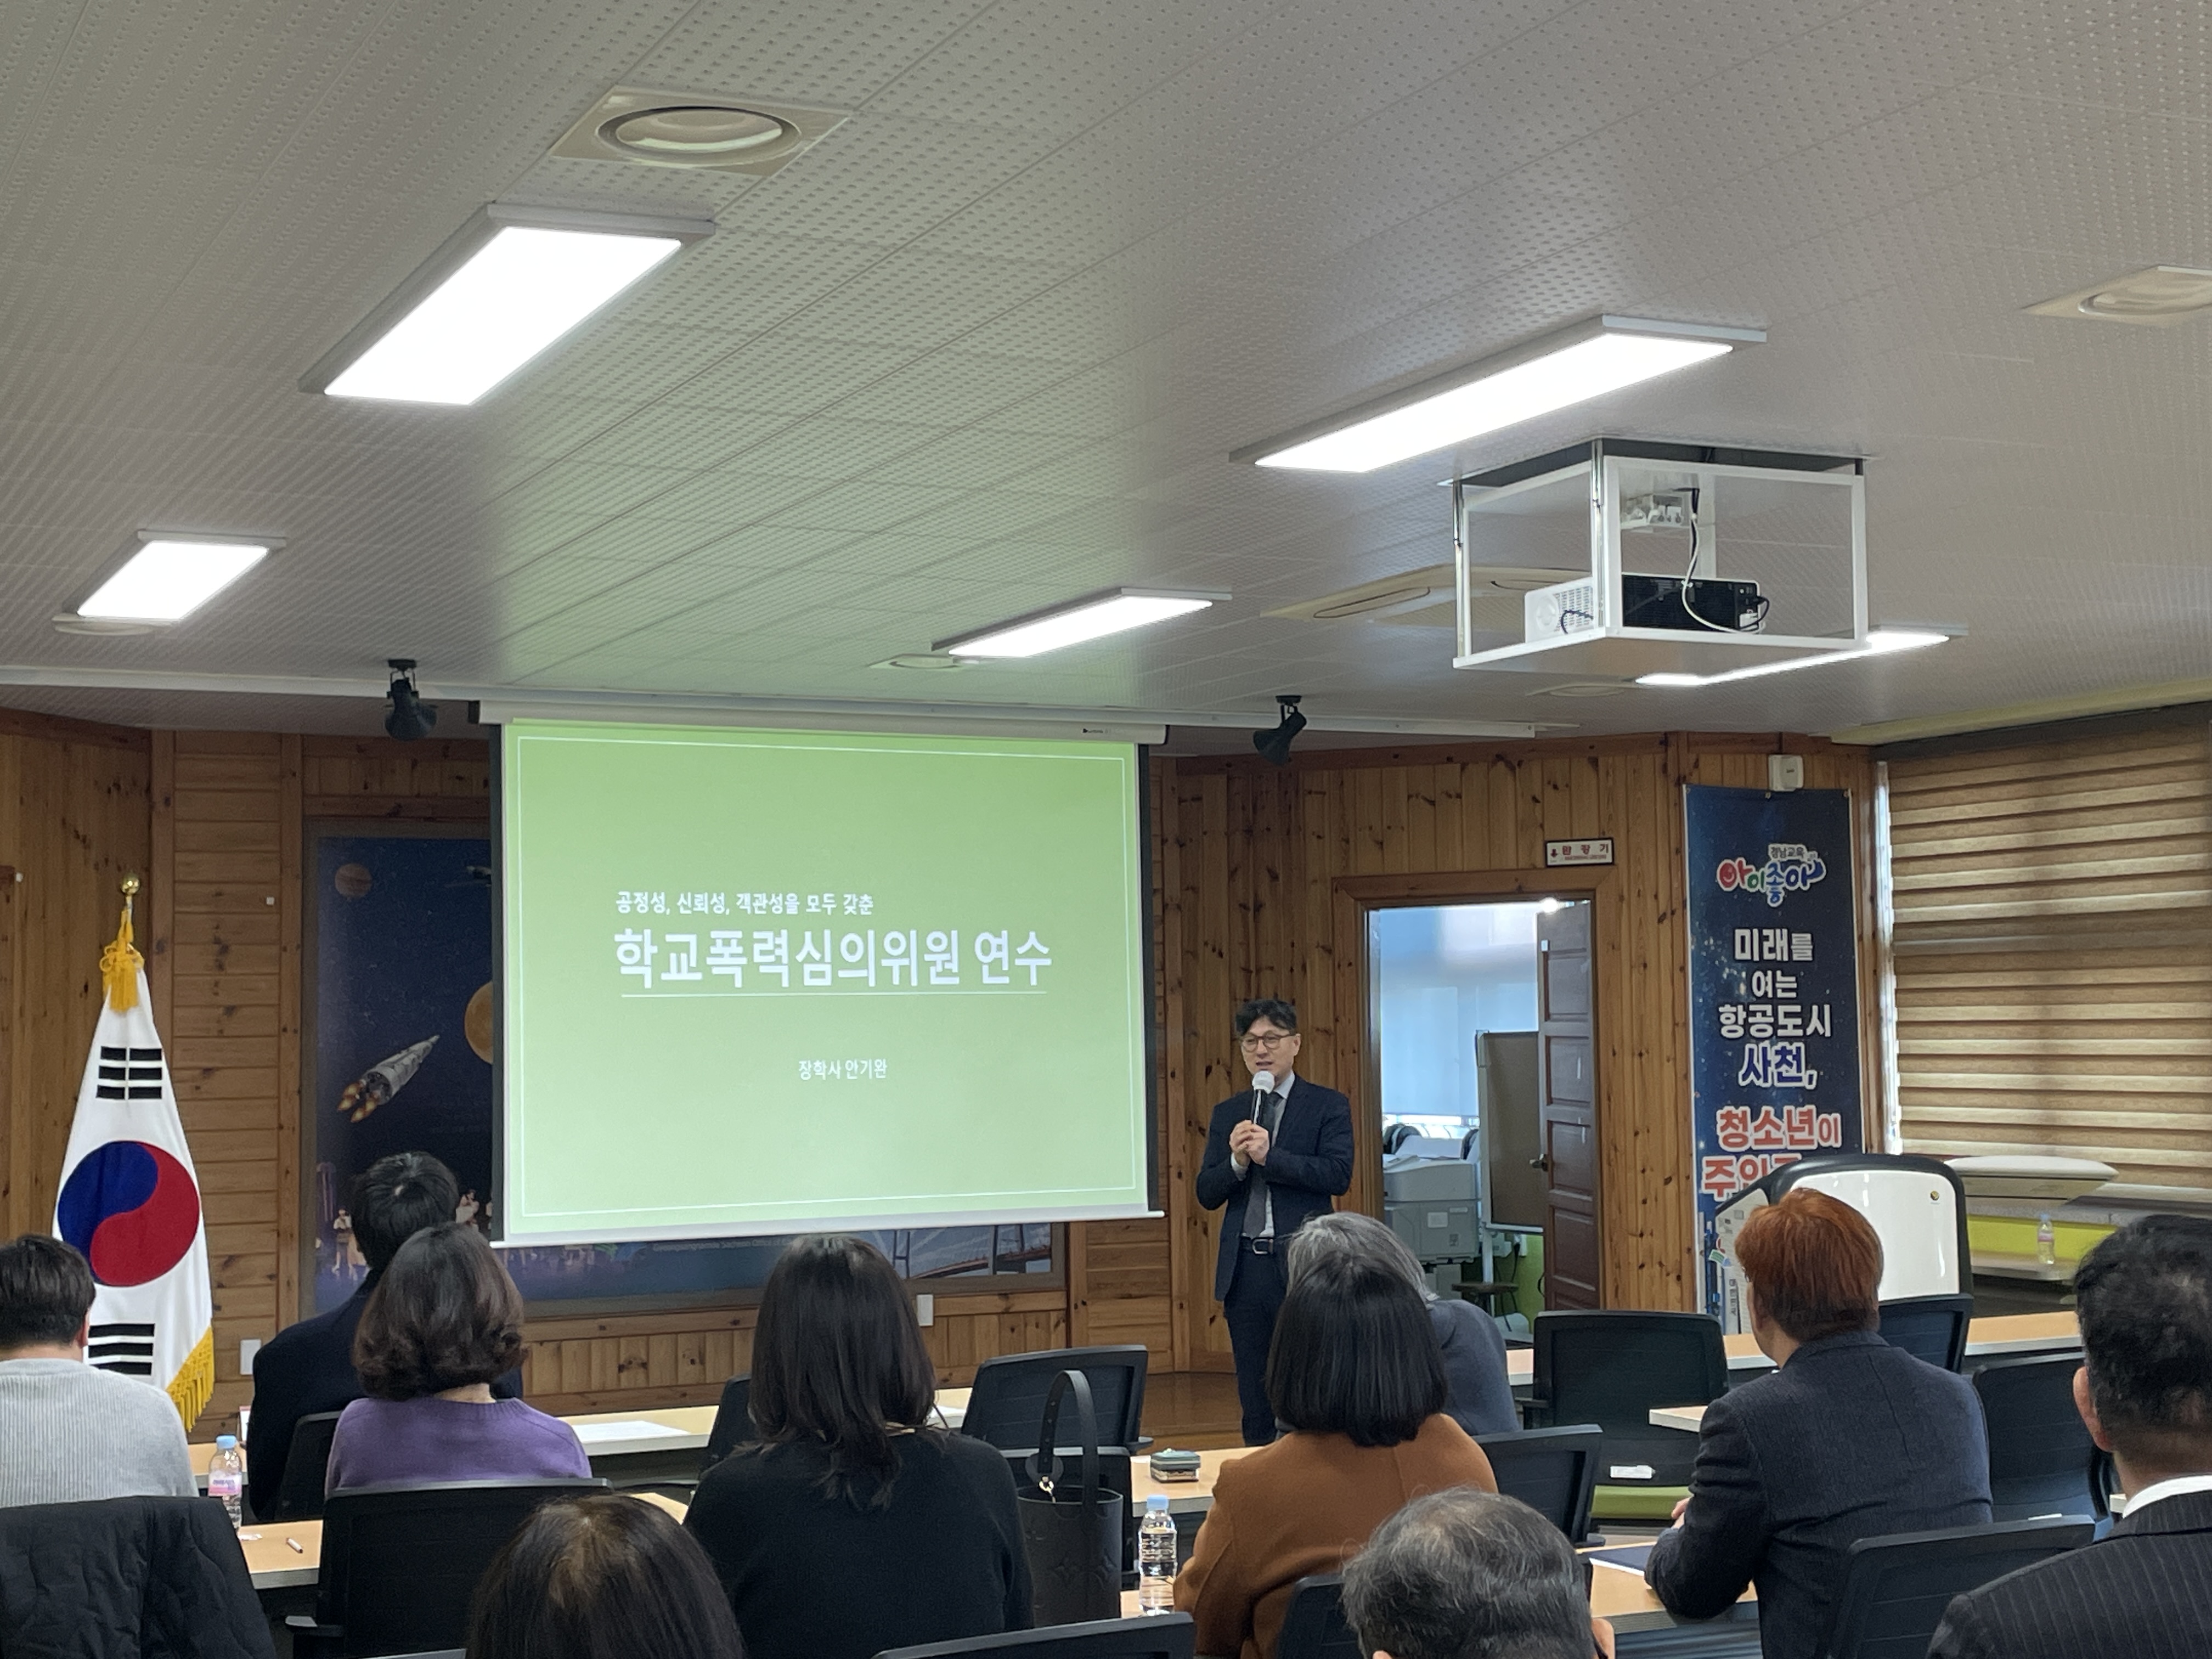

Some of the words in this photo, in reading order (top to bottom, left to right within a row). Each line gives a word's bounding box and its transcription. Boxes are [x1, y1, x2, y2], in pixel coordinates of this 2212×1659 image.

[616, 891, 670, 915] 공정성,
[677, 892, 729, 915] 신뢰성,
[736, 893, 799, 915] 객관성을
[805, 893, 837, 915] 모두
[843, 894, 873, 915] 갖춘
[974, 930, 1052, 986] 연수
[1734, 928, 1813, 961] 미래를
[1752, 970, 1798, 998] 여는
[1718, 1004, 1831, 1038] 항공도시
[799, 1059, 841, 1080] 장학사
[1739, 1042, 1817, 1088] 사천,
[1717, 1105, 1841, 1150] 청소년이
[1702, 1154, 1802, 1201] 주인
